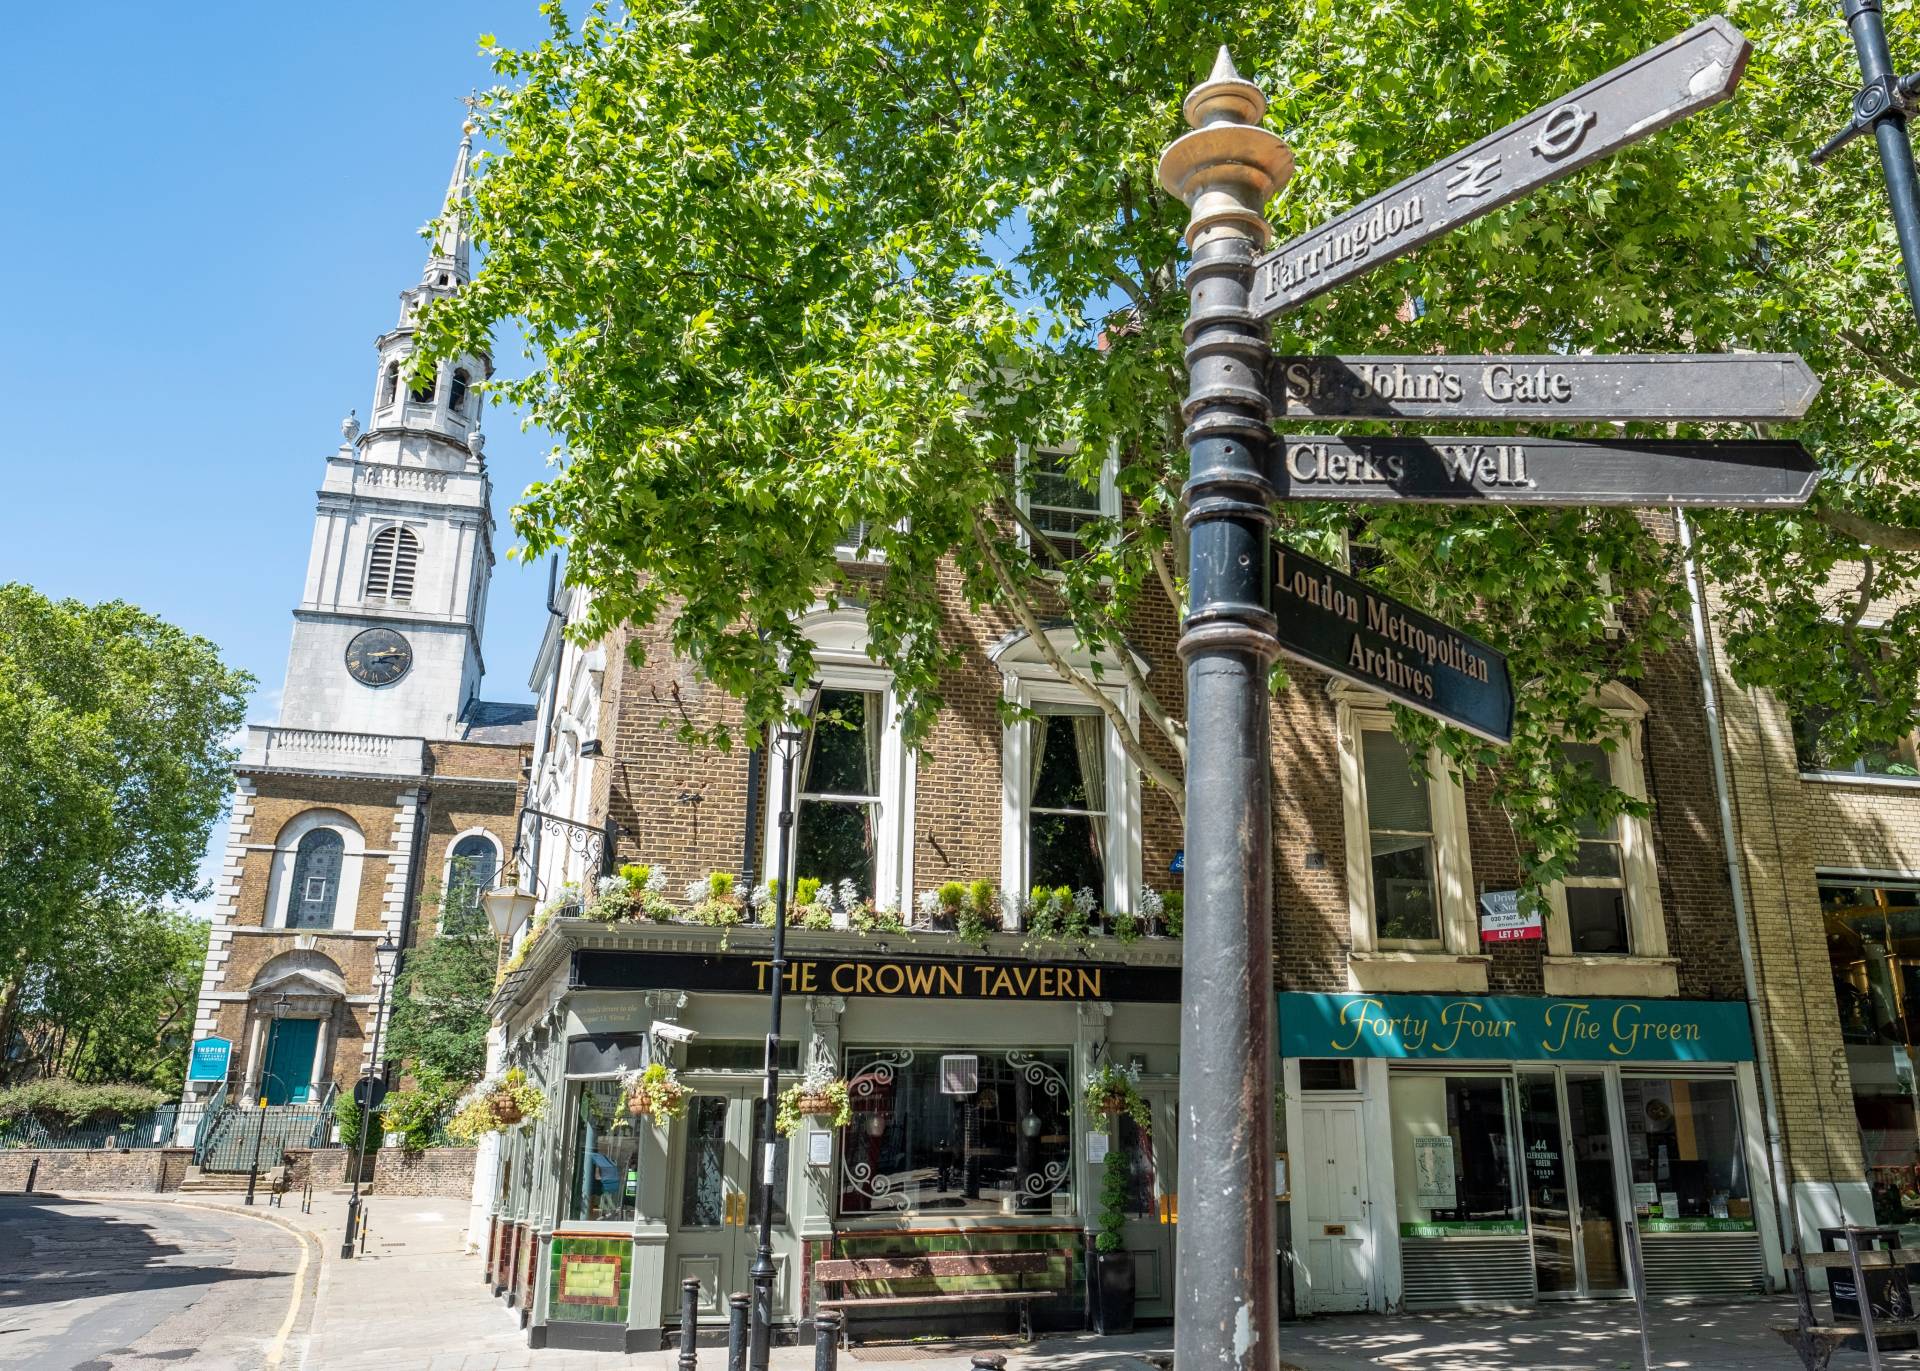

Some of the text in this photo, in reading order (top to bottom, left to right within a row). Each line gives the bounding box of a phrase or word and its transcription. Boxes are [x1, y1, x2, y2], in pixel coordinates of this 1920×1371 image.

[1265, 195, 1423, 299] Farringdon
[1286, 363, 1572, 401] St. John's Gate
[1286, 443, 1530, 486] Clerks Well
[1275, 550, 1489, 683] London Metropolitan
[1349, 632, 1434, 699] Archives
[1498, 929, 1525, 939] LET BY
[751, 961, 1101, 997] THE CROWN TAVERN
[1331, 999, 1702, 1055] Forty Four The Green
[1536, 1140, 1547, 1150] 44
